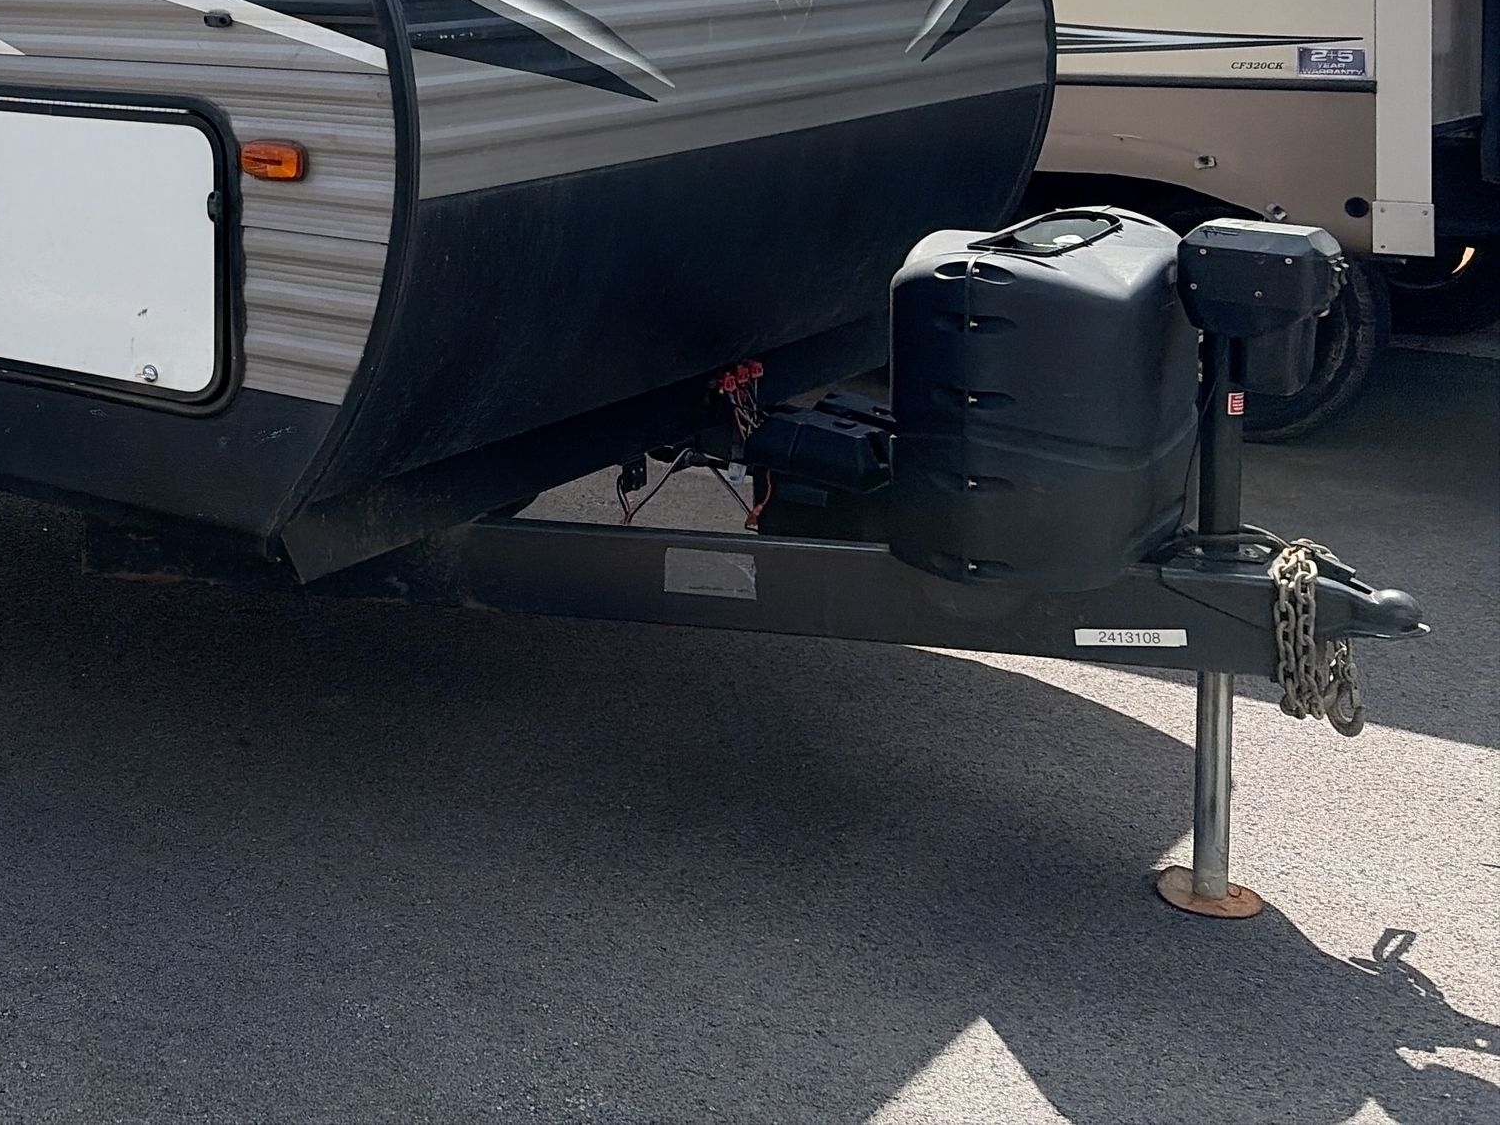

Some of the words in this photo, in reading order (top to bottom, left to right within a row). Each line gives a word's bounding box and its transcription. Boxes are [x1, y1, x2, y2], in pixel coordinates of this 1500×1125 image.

[1310, 49, 1354, 63] 2+5
[1230, 61, 1285, 71] CF320CK
[1098, 631, 1161, 644] 2413108
